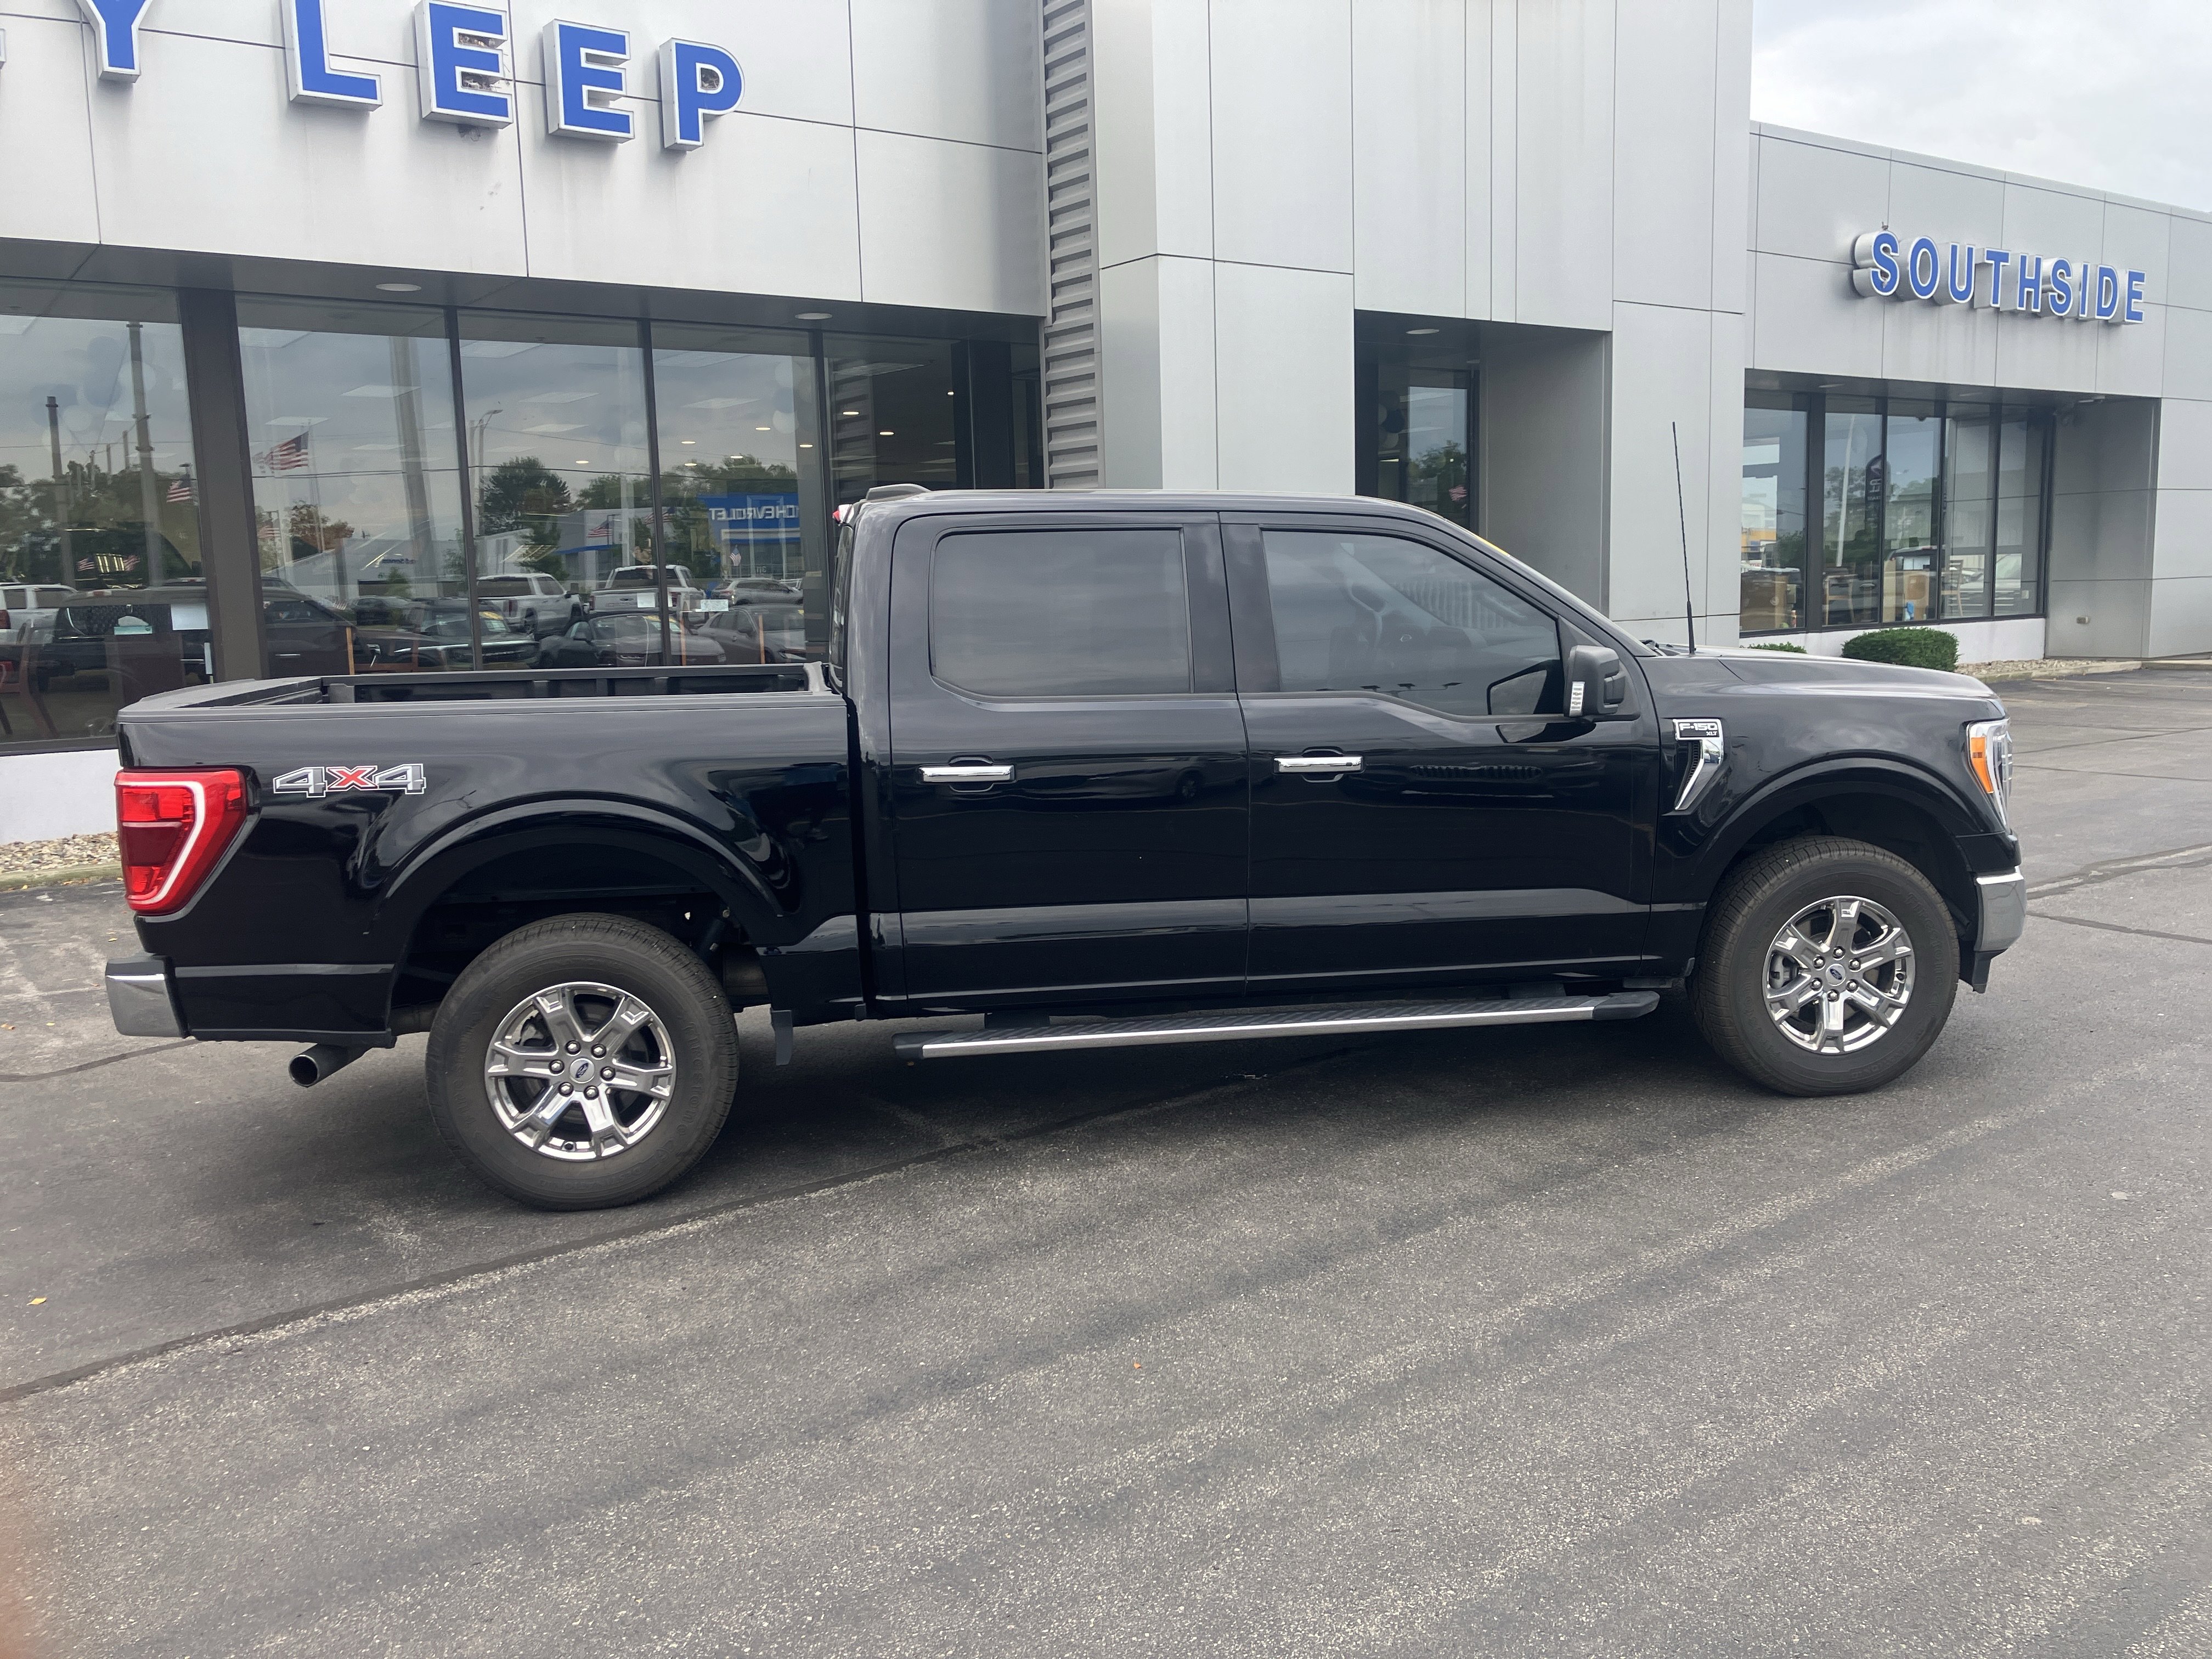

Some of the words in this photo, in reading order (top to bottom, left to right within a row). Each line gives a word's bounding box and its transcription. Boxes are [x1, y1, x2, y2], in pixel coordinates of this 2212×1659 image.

[280, 0, 745, 151] LEEP
[1853, 231, 2146, 324] SOUTHSIDE
[1679, 723, 1718, 731] F-150
